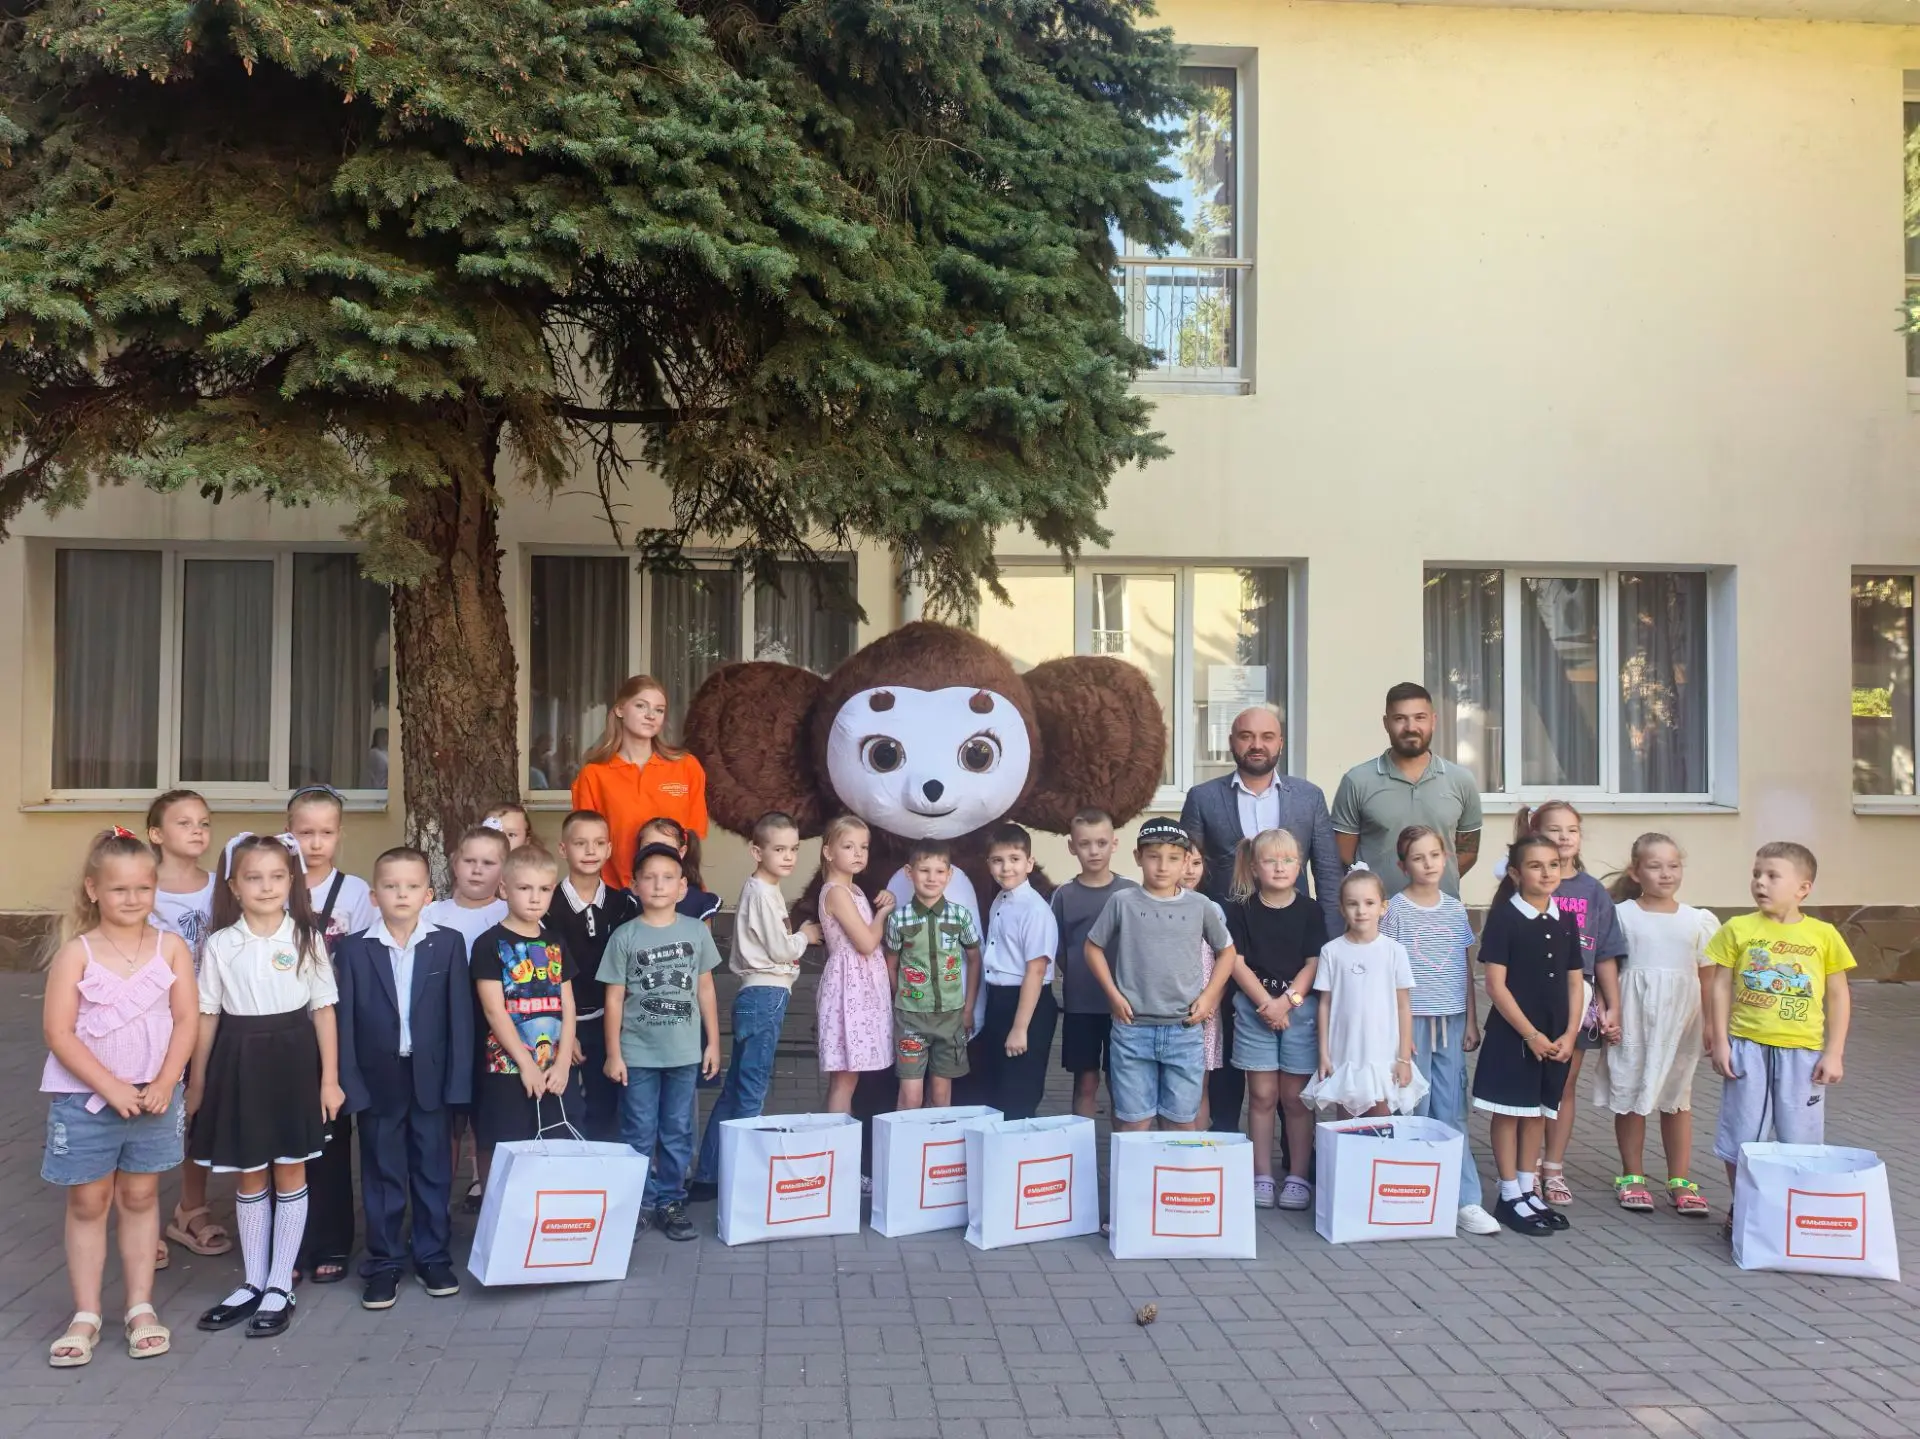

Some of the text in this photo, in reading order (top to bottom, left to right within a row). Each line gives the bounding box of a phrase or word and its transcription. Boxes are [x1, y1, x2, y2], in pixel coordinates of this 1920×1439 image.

[1769, 941, 1817, 956] Speed
[506, 997, 562, 1014] ROBLO
[661, 1002, 677, 1011] FREE
[1779, 997, 1809, 1021] 52
[545, 1222, 592, 1230] #МЫВМЕСТЕ
[1800, 1219, 1853, 1227] #МЫВМЕСТЕ
